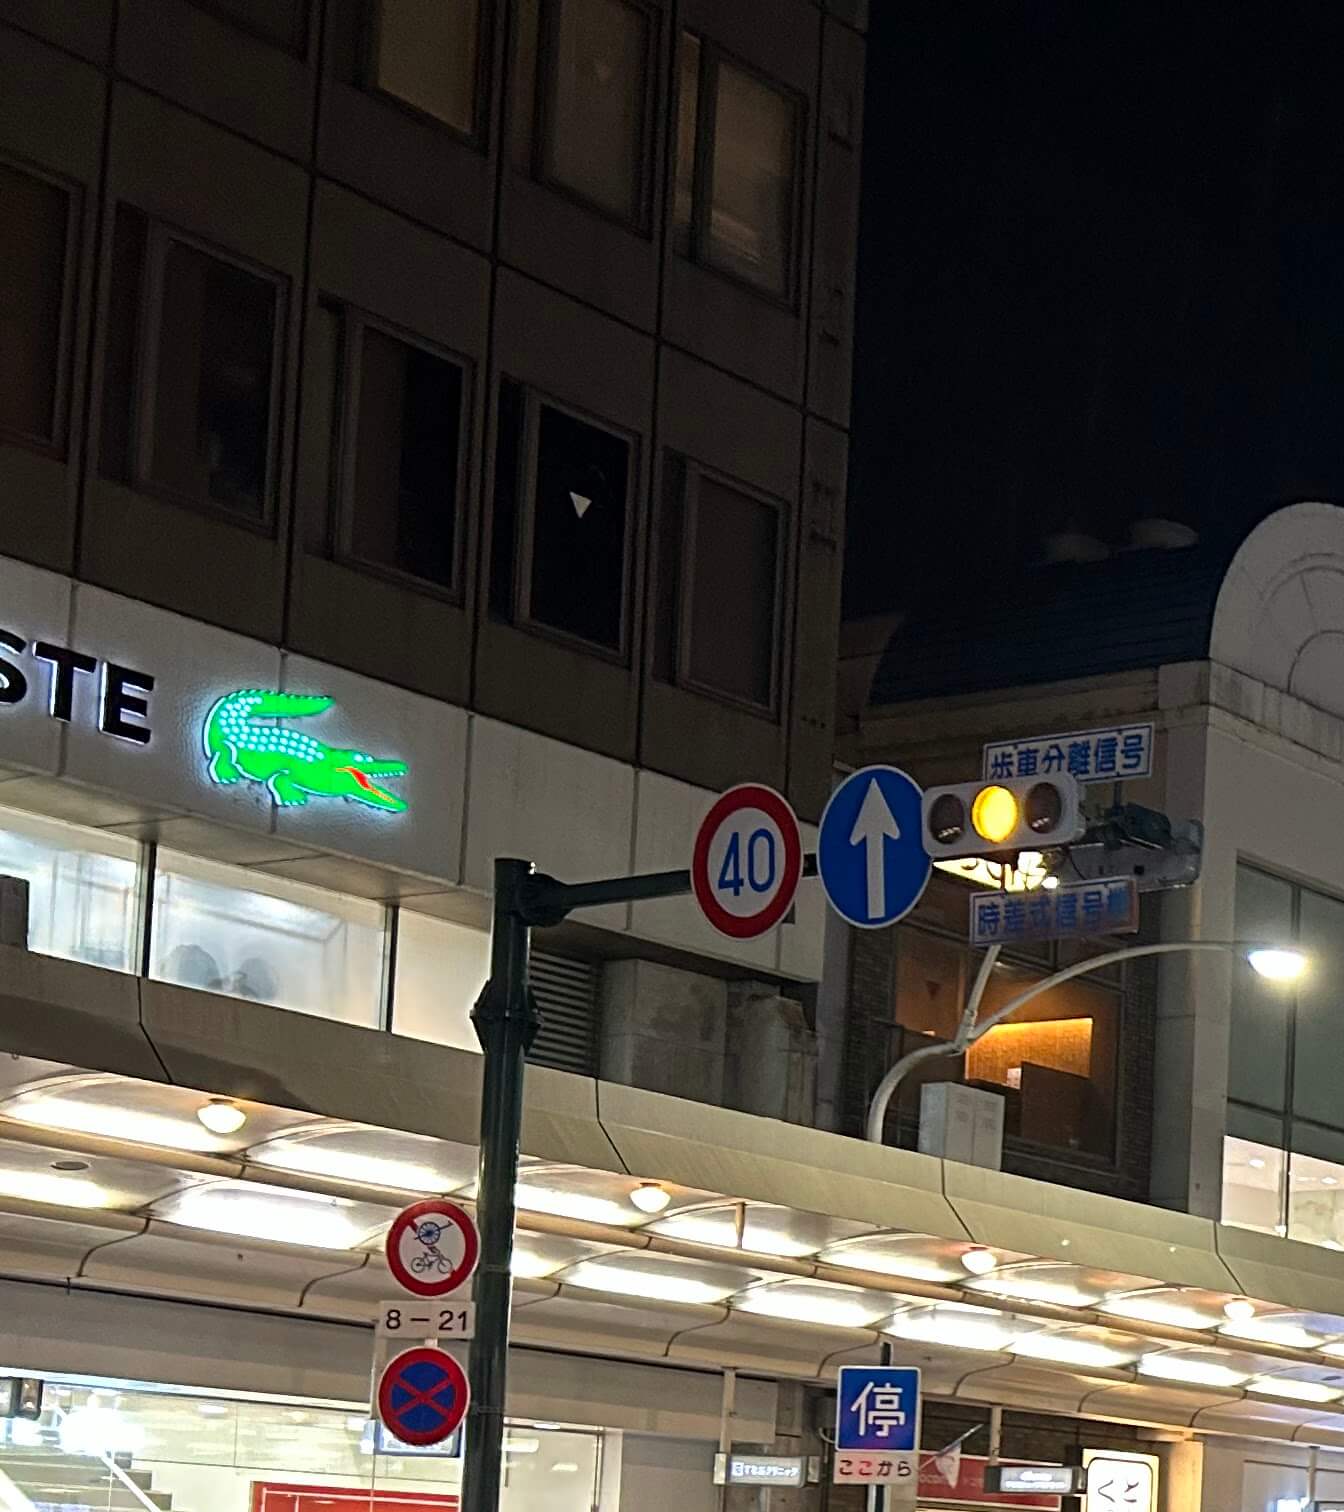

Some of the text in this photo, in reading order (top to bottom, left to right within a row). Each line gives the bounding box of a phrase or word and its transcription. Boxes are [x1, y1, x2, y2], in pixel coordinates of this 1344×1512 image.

[990, 734, 1145, 779] 歩車分離信号
[718, 828, 776, 897] 40
[850, 1381, 905, 1437] 停
[840, 1459, 912, 1477] ここから
